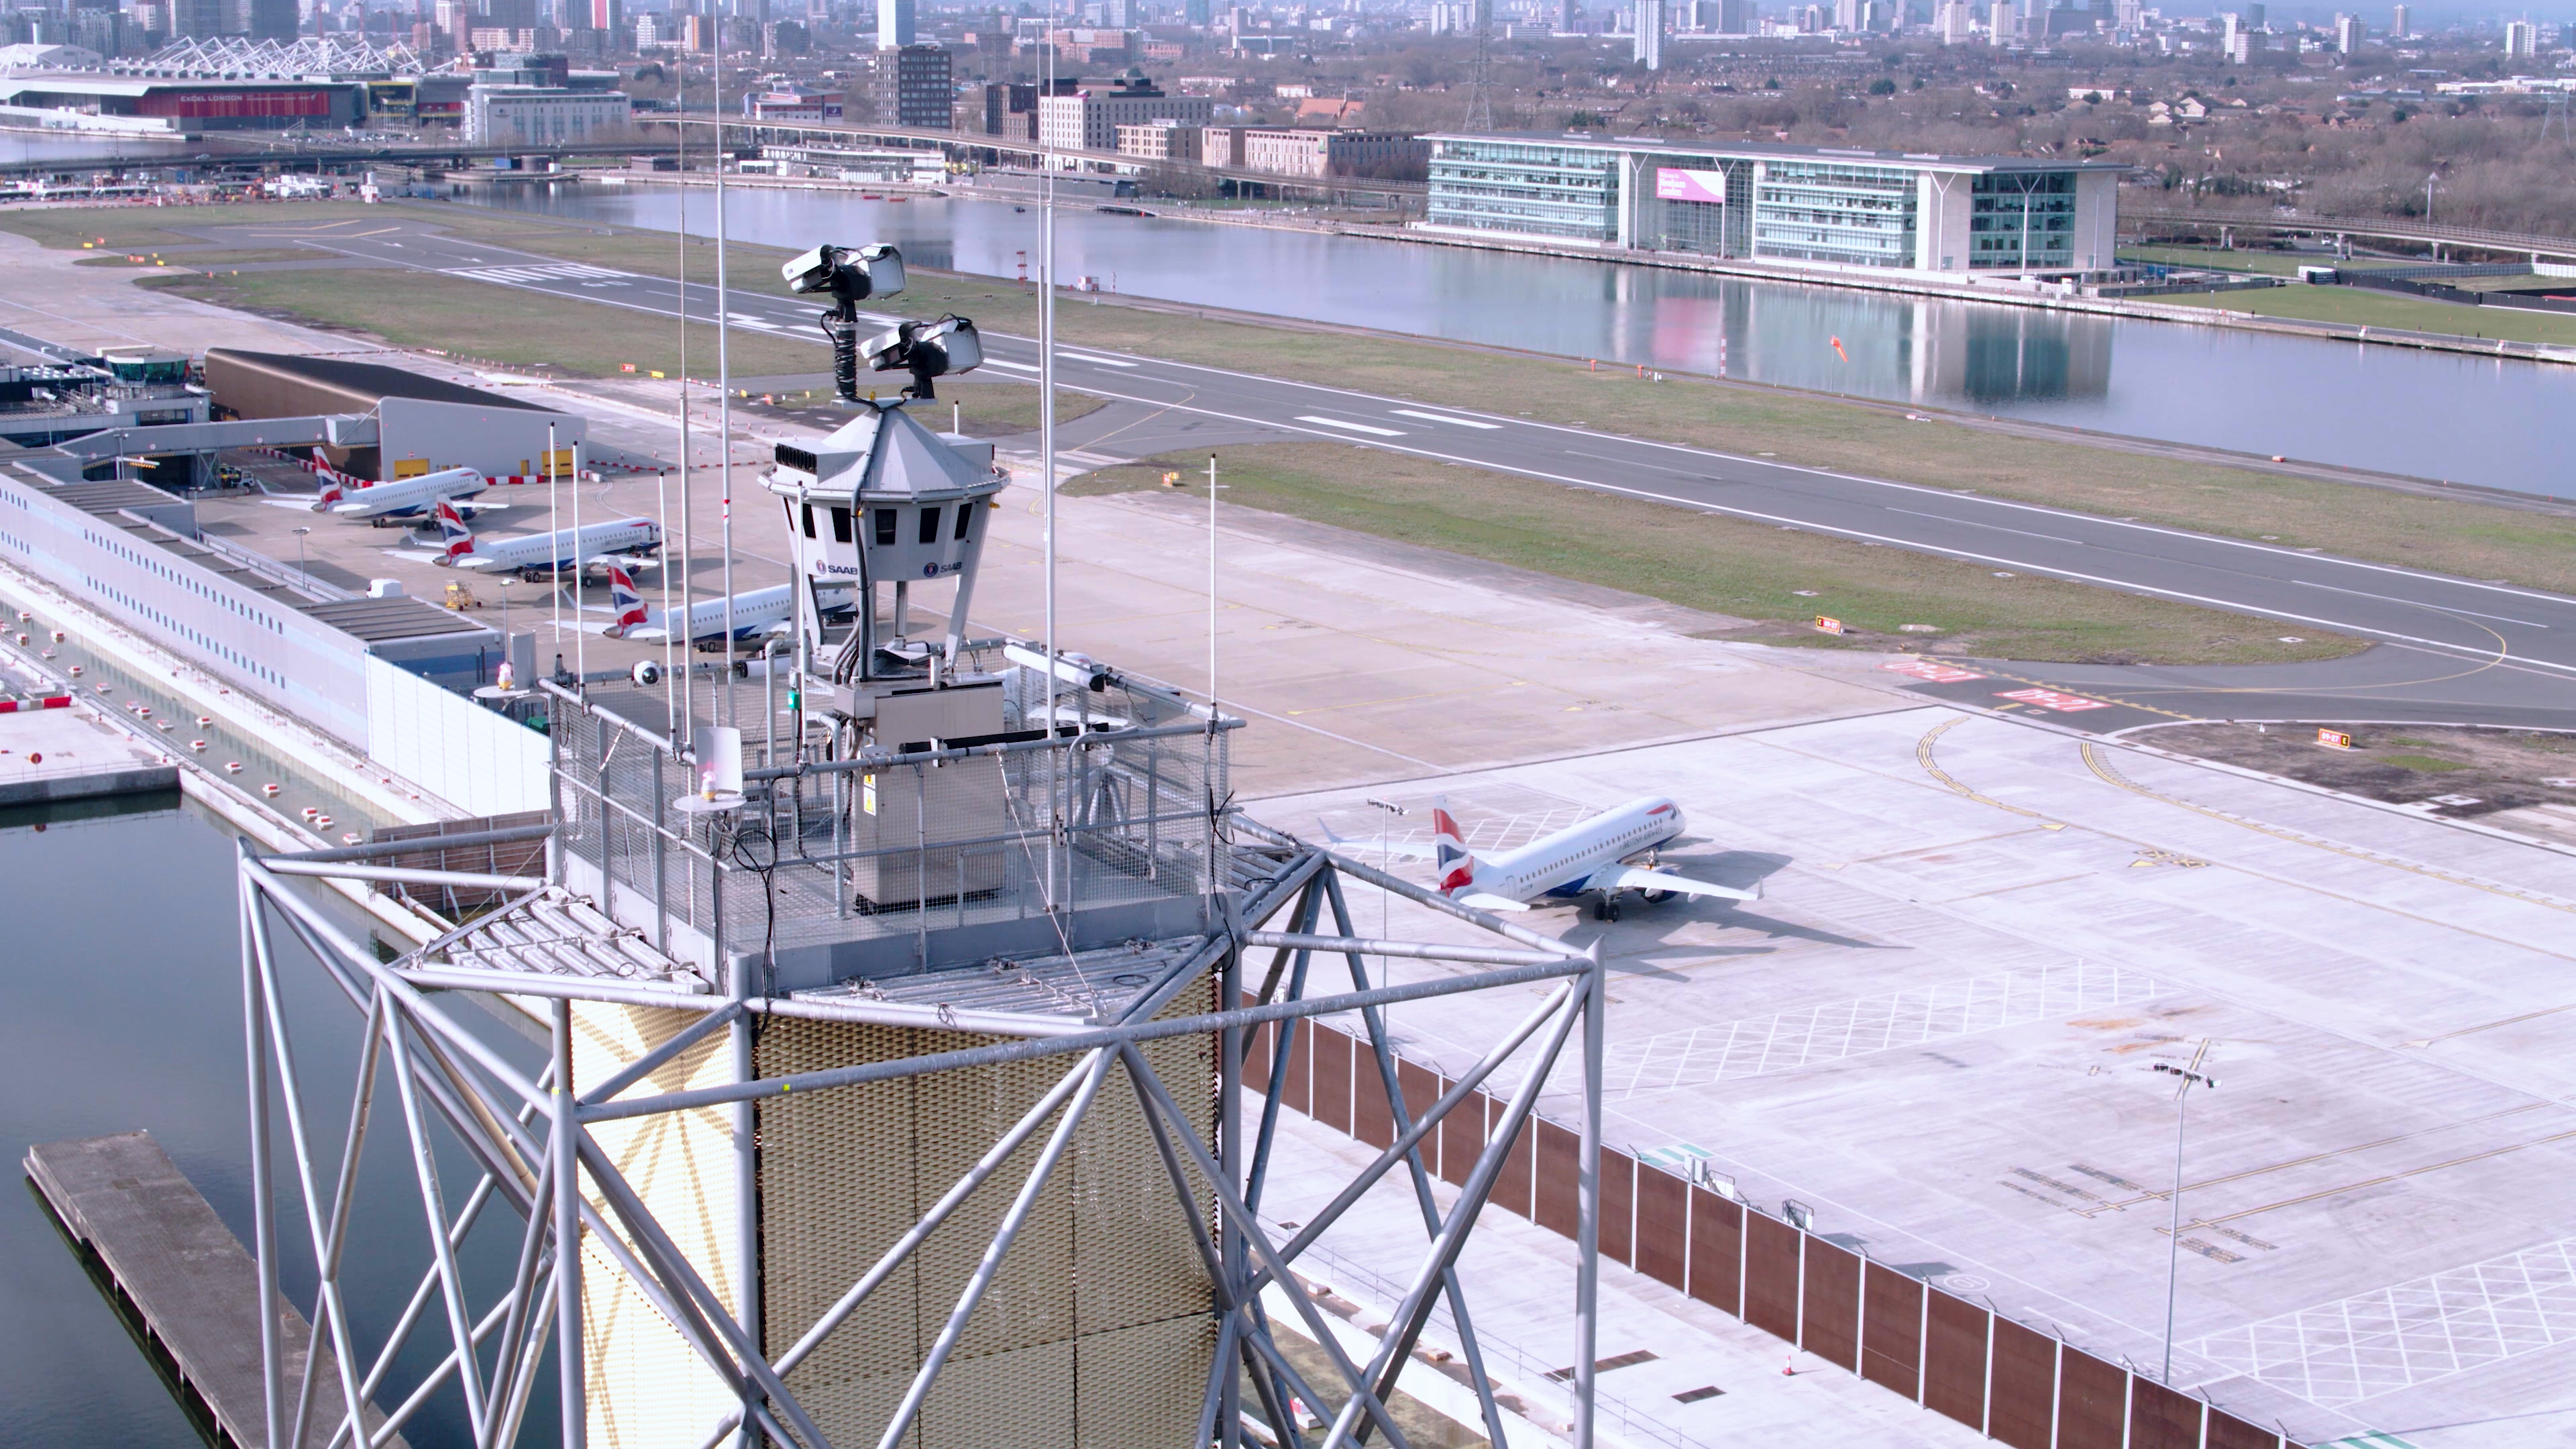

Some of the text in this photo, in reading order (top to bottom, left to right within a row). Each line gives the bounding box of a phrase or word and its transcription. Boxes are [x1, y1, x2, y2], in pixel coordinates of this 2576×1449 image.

[1658, 178, 1686, 188] Newham
[1658, 186, 1682, 197] London
[828, 565, 858, 575] SAAB
[941, 561, 962, 573] SAAB
[1824, 620, 1837, 629] 09-27
[1884, 662, 1981, 682] 09-27
[2003, 690, 2104, 710] 09-27
[2321, 732, 2347, 745] 09-27 E
